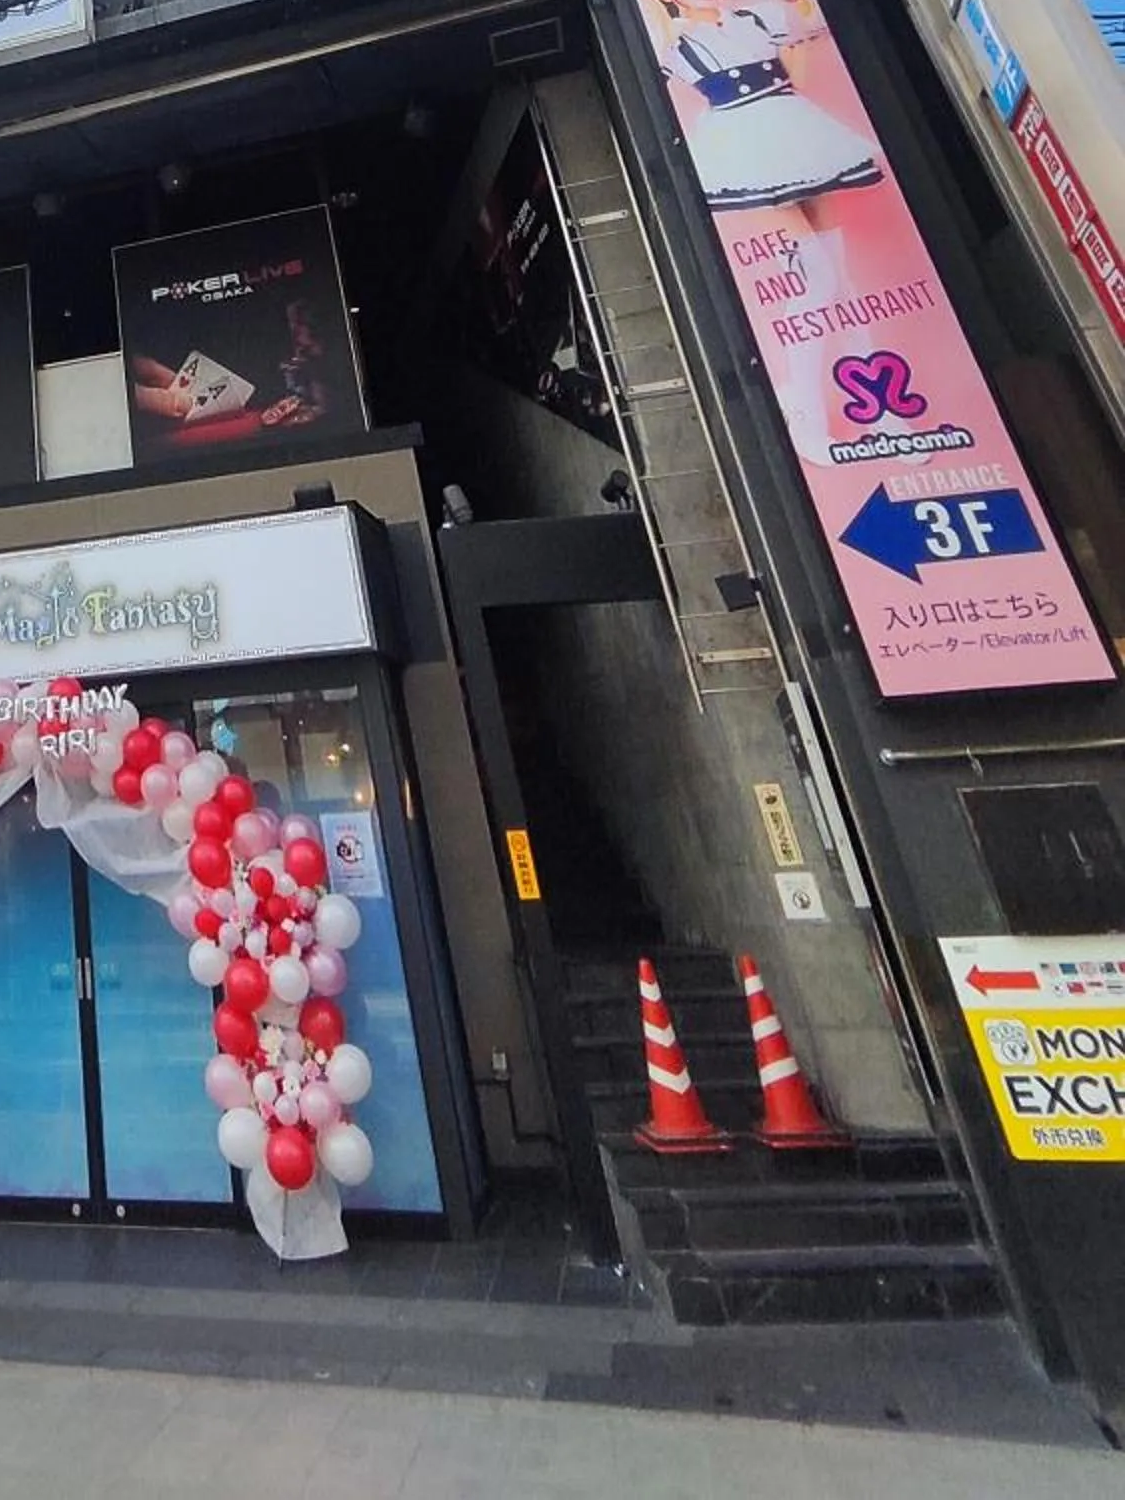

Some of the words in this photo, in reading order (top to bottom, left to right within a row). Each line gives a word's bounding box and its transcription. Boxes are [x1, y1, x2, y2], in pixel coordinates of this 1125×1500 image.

[201, 285, 254, 303] OSAKA
[754, 269, 806, 307] AND
[772, 279, 937, 348] RESTAURANT
[829, 424, 974, 464] maidreamin
[888, 463, 1009, 499] ENTRANCE
[914, 500, 994, 558] 3F
[82, 583, 221, 650] Fantasy
[884, 592, 1060, 631] 入り口はこちら
